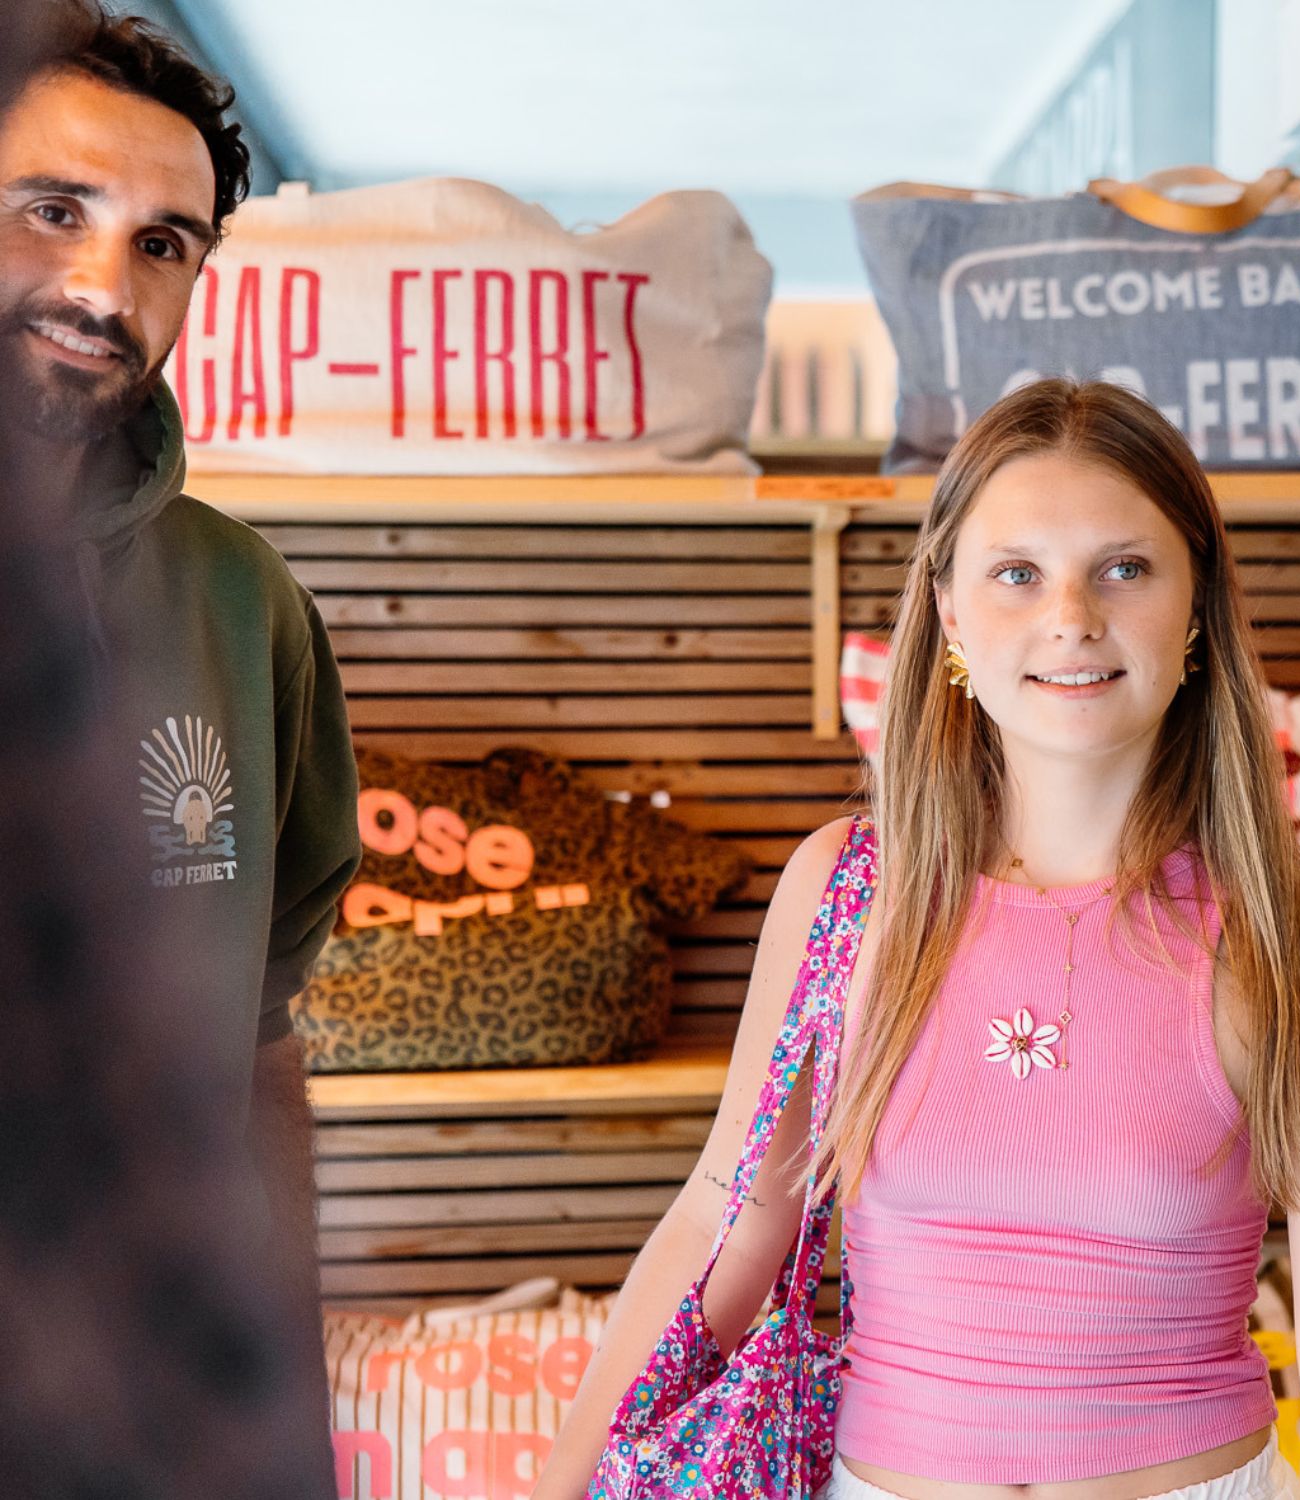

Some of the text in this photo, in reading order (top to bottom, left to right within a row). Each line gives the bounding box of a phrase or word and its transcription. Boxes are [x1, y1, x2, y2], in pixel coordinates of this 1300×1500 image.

[968, 266, 1222, 322] WELCOME
[358, 788, 534, 890] ose
[151, 860, 237, 888] CAP FERRET
[366, 1332, 595, 1402] rose
